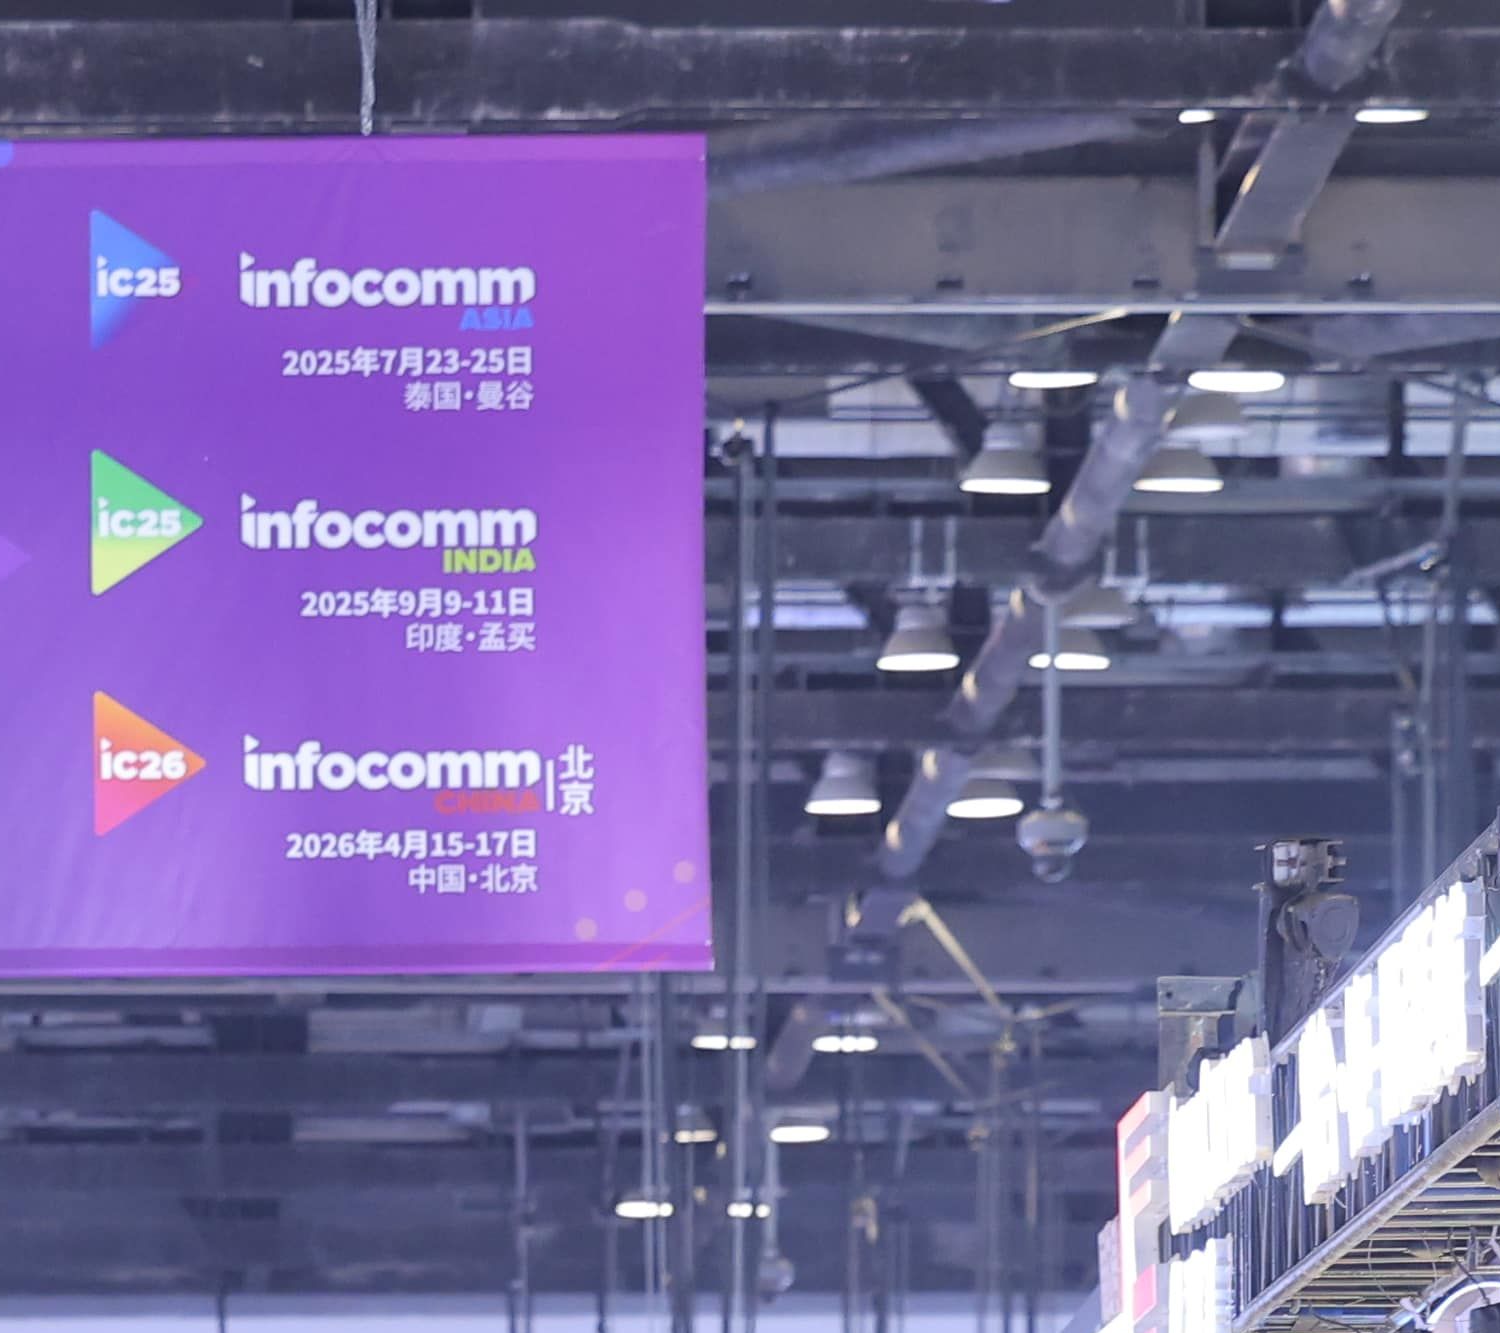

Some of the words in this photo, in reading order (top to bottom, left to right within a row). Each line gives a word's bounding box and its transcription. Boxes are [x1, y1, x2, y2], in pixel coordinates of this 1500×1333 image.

[240, 251, 537, 307] infocomm
[459, 307, 534, 331] ASIA
[281, 345, 533, 377] 2025年7月23-25日
[240, 492, 537, 549] infocomm
[442, 548, 536, 574] INDIA
[300, 587, 534, 617] 2025年9月9-11日
[243, 733, 541, 791] infocomm
[559, 743, 595, 816] 北京
[286, 829, 538, 859] 2026年4月15-17日
